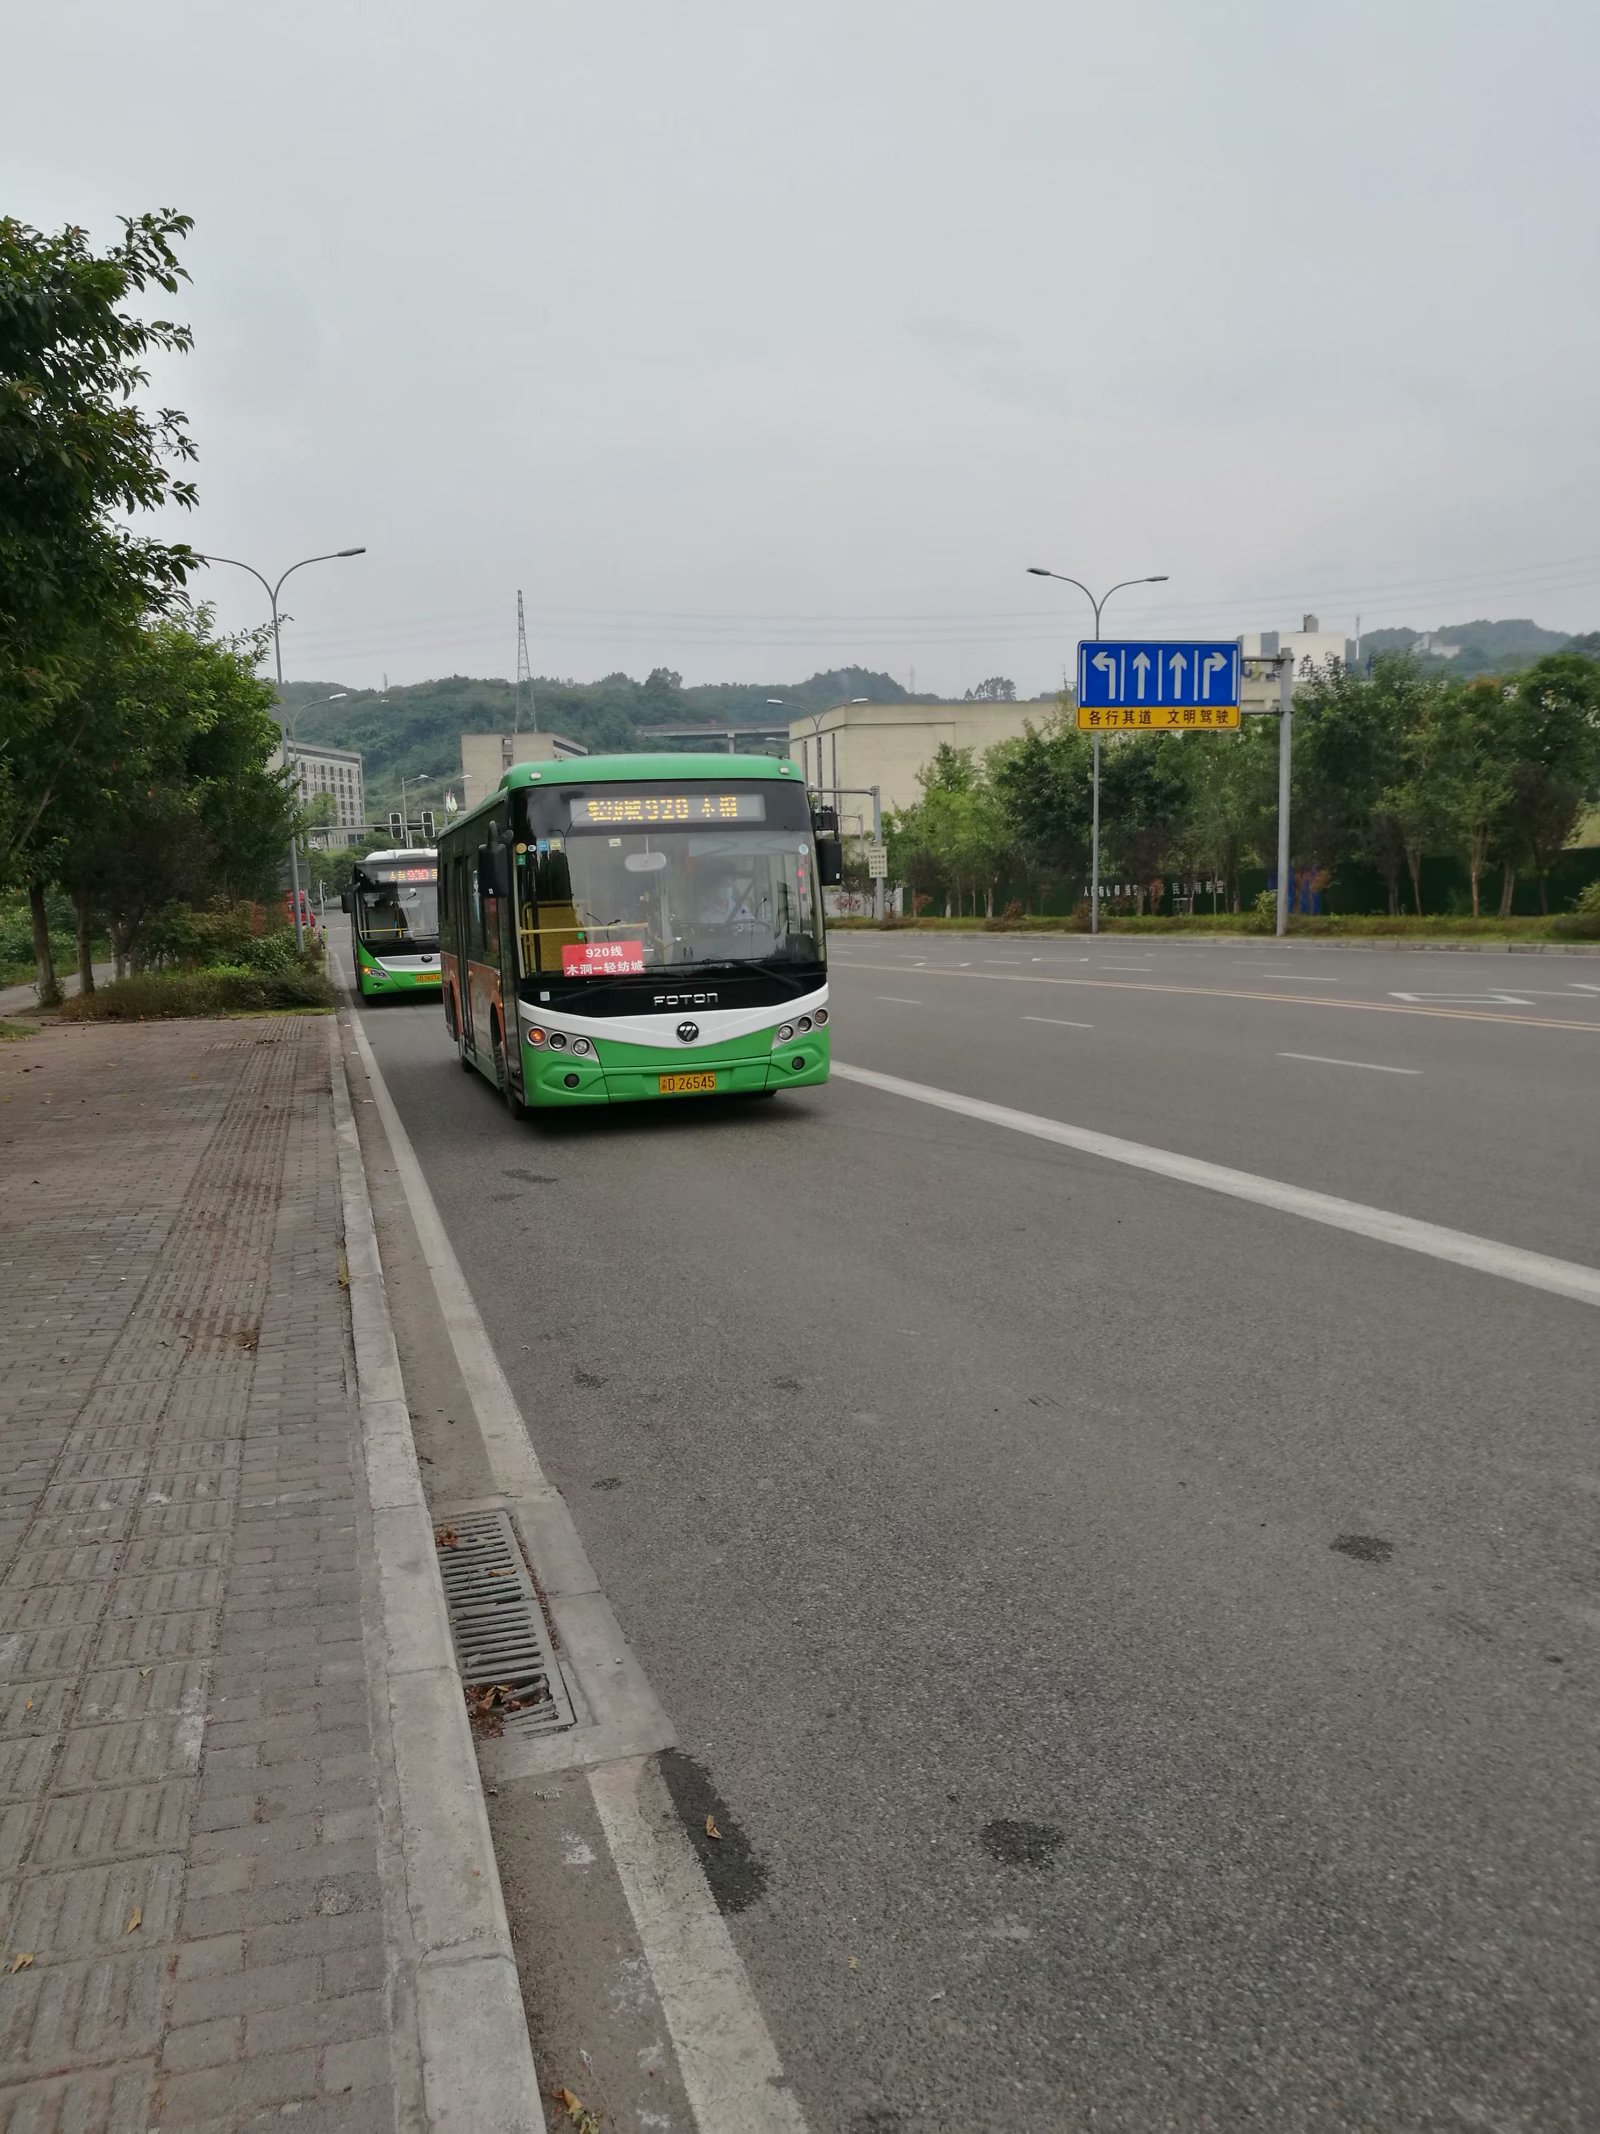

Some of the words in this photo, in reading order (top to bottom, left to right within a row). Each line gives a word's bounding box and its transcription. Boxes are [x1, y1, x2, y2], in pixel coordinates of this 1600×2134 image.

[1089, 710, 1152, 725] 各行其道
[1167, 709, 1229, 724] 文明驾驶
[585, 945, 624, 958] 920线
[653, 992, 719, 1007] FOTON
